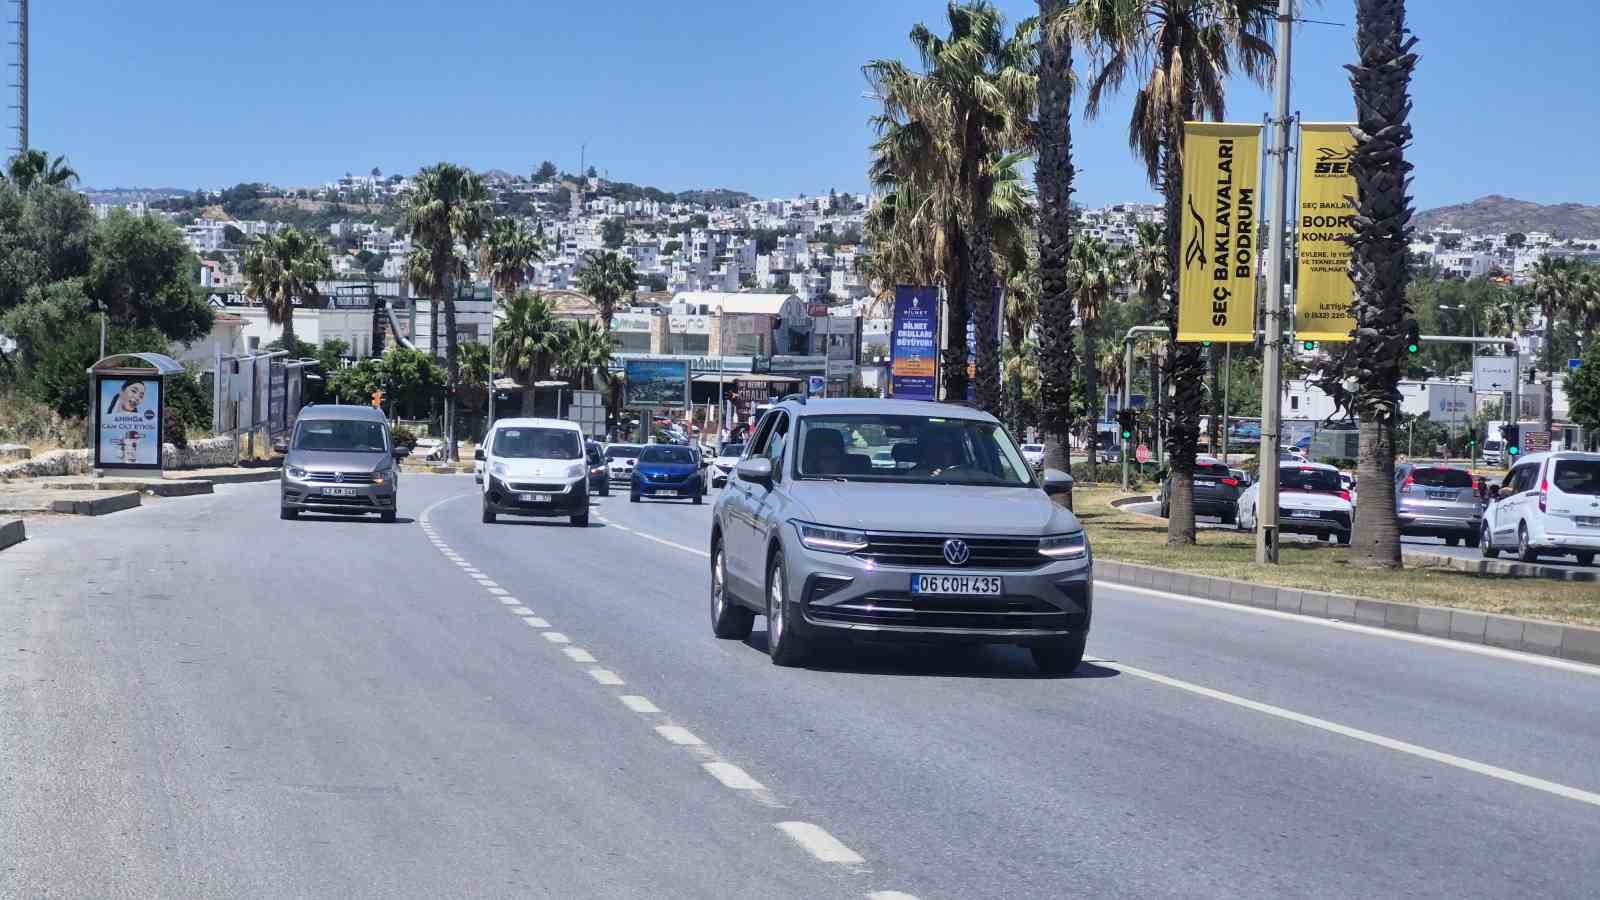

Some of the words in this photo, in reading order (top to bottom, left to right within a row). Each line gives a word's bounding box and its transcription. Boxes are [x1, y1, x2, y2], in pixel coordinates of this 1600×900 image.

[1315, 162, 1351, 173] SE
[1214, 139, 1233, 281] BAKLAVALARI
[1302, 202, 1317, 210] SEÇ
[1302, 215, 1350, 228] BODR
[1236, 188, 1253, 278] BODRUM
[1213, 287, 1232, 326] SEÇ
[920, 576, 938, 592] 06
[941, 577, 969, 592] COH
[972, 577, 999, 593] 435
